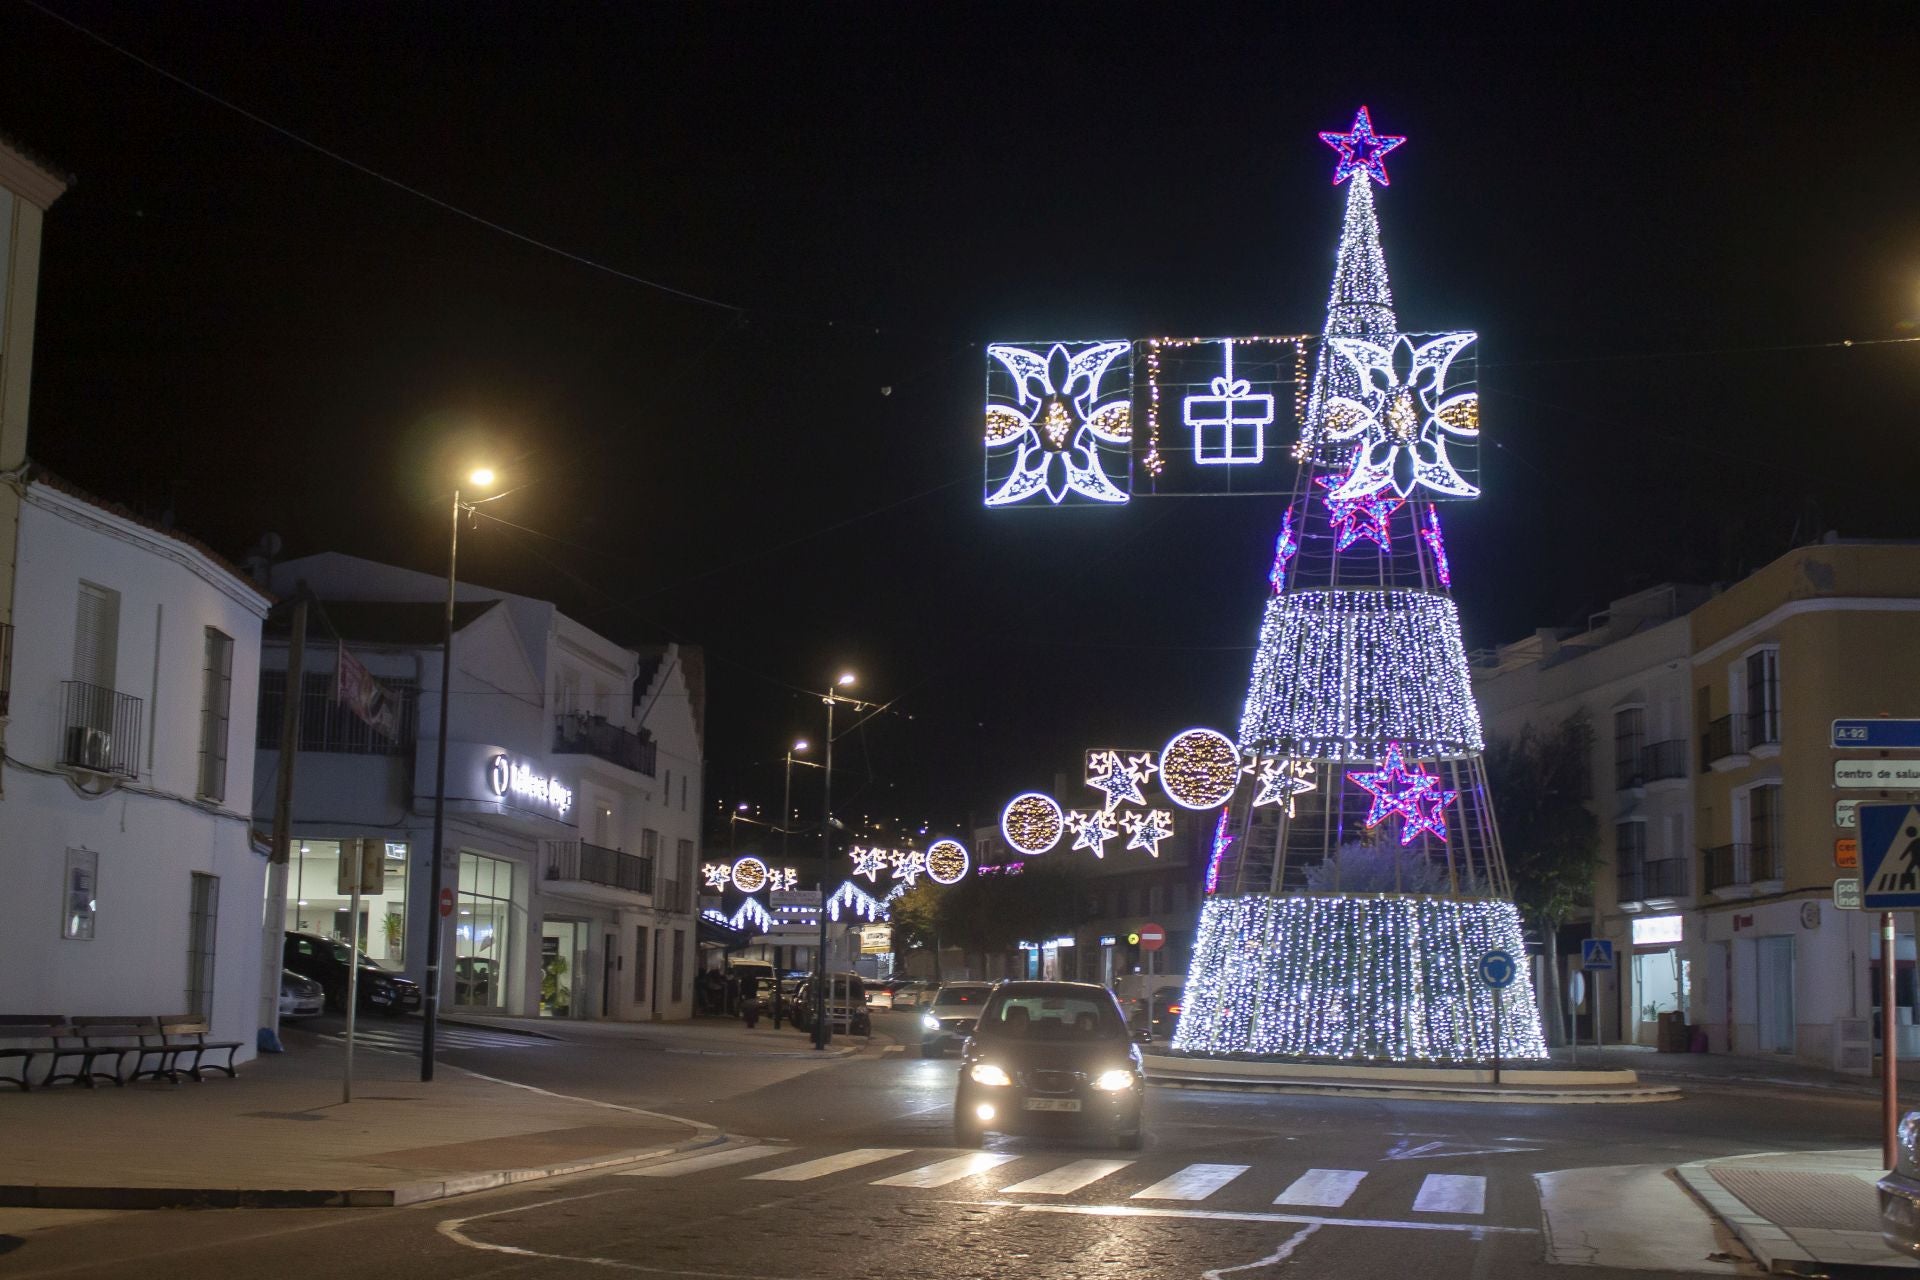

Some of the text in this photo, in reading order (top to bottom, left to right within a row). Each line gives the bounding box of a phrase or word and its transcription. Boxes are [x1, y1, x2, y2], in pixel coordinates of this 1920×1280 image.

[1838, 728, 1865, 738] A-92
[1837, 769, 1920, 779] centro de salu
